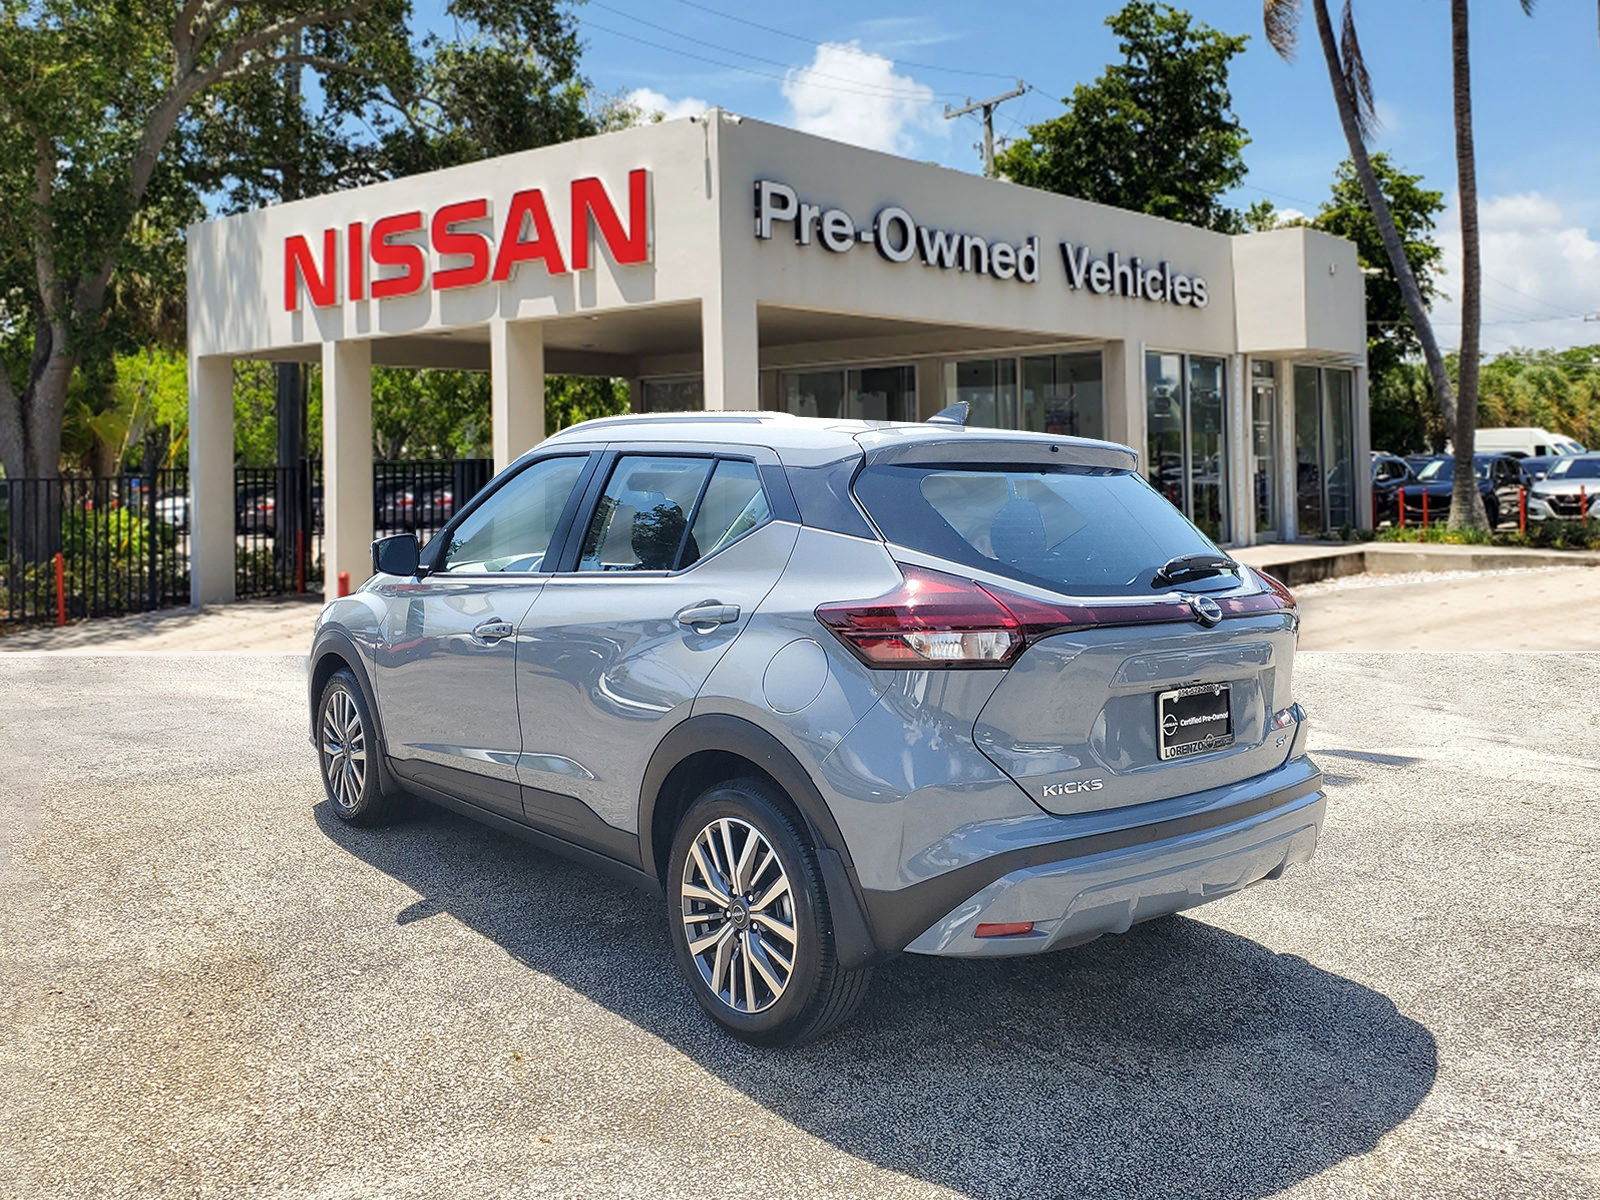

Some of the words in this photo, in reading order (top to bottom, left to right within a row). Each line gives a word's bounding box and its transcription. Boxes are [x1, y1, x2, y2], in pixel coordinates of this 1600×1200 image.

[284, 168, 651, 312] NISSAN
[754, 179, 1039, 283] Pre-Owned
[1060, 241, 1209, 308] Vehicles
[1180, 716, 1201, 727] Certified
[1202, 711, 1229, 722] Pre-Owned
[1165, 741, 1204, 758] LORENZO
[1042, 778, 1104, 797] KICKS
